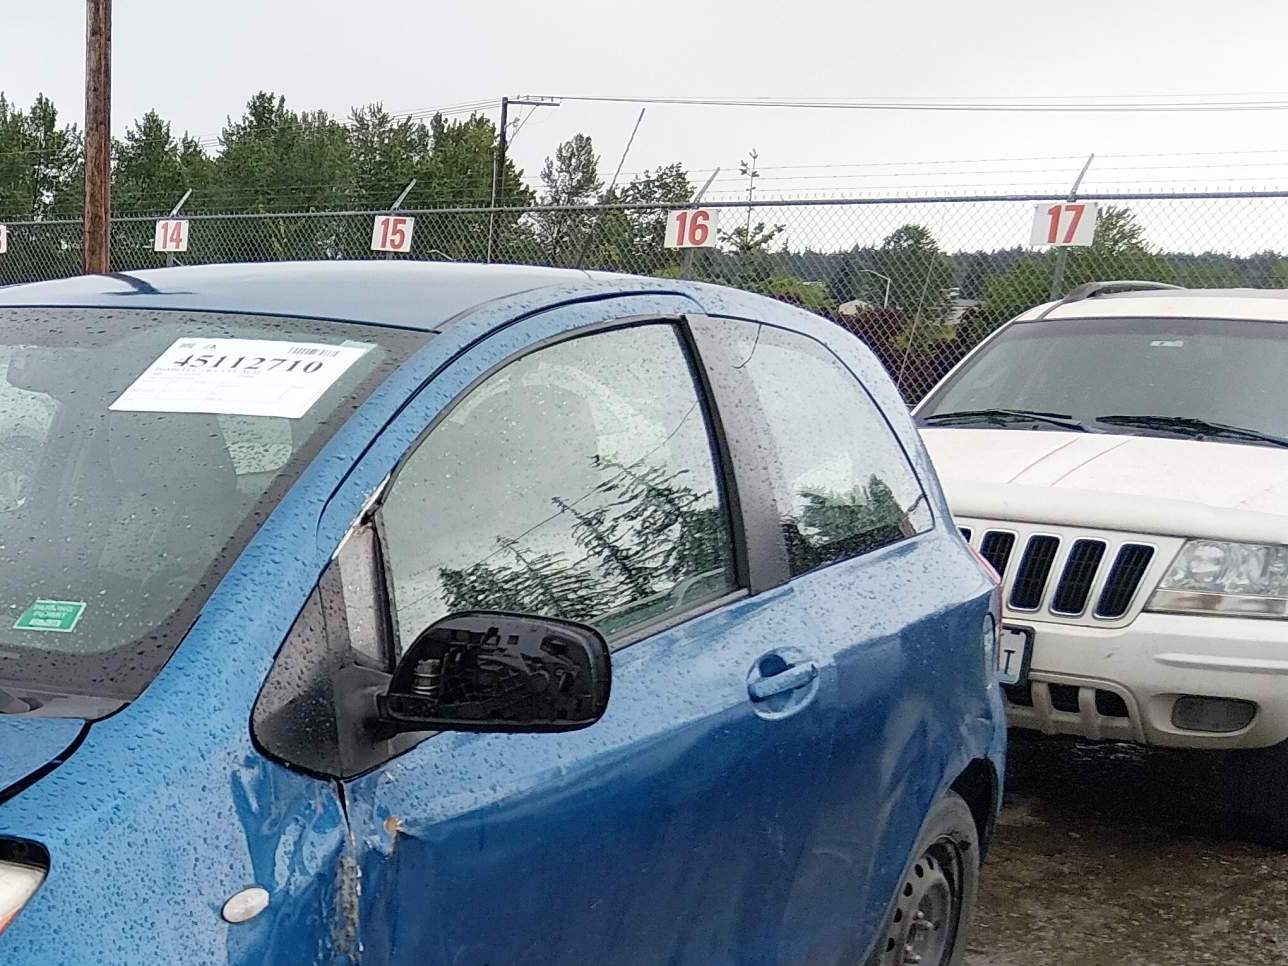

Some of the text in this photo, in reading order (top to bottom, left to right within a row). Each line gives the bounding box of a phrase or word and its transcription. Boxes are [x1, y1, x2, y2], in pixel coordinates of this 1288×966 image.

[161, 221, 183, 250] 14
[380, 217, 407, 250] 15
[675, 210, 710, 246] 16
[1047, 204, 1085, 244] 17
[173, 353, 324, 374] 45112710
